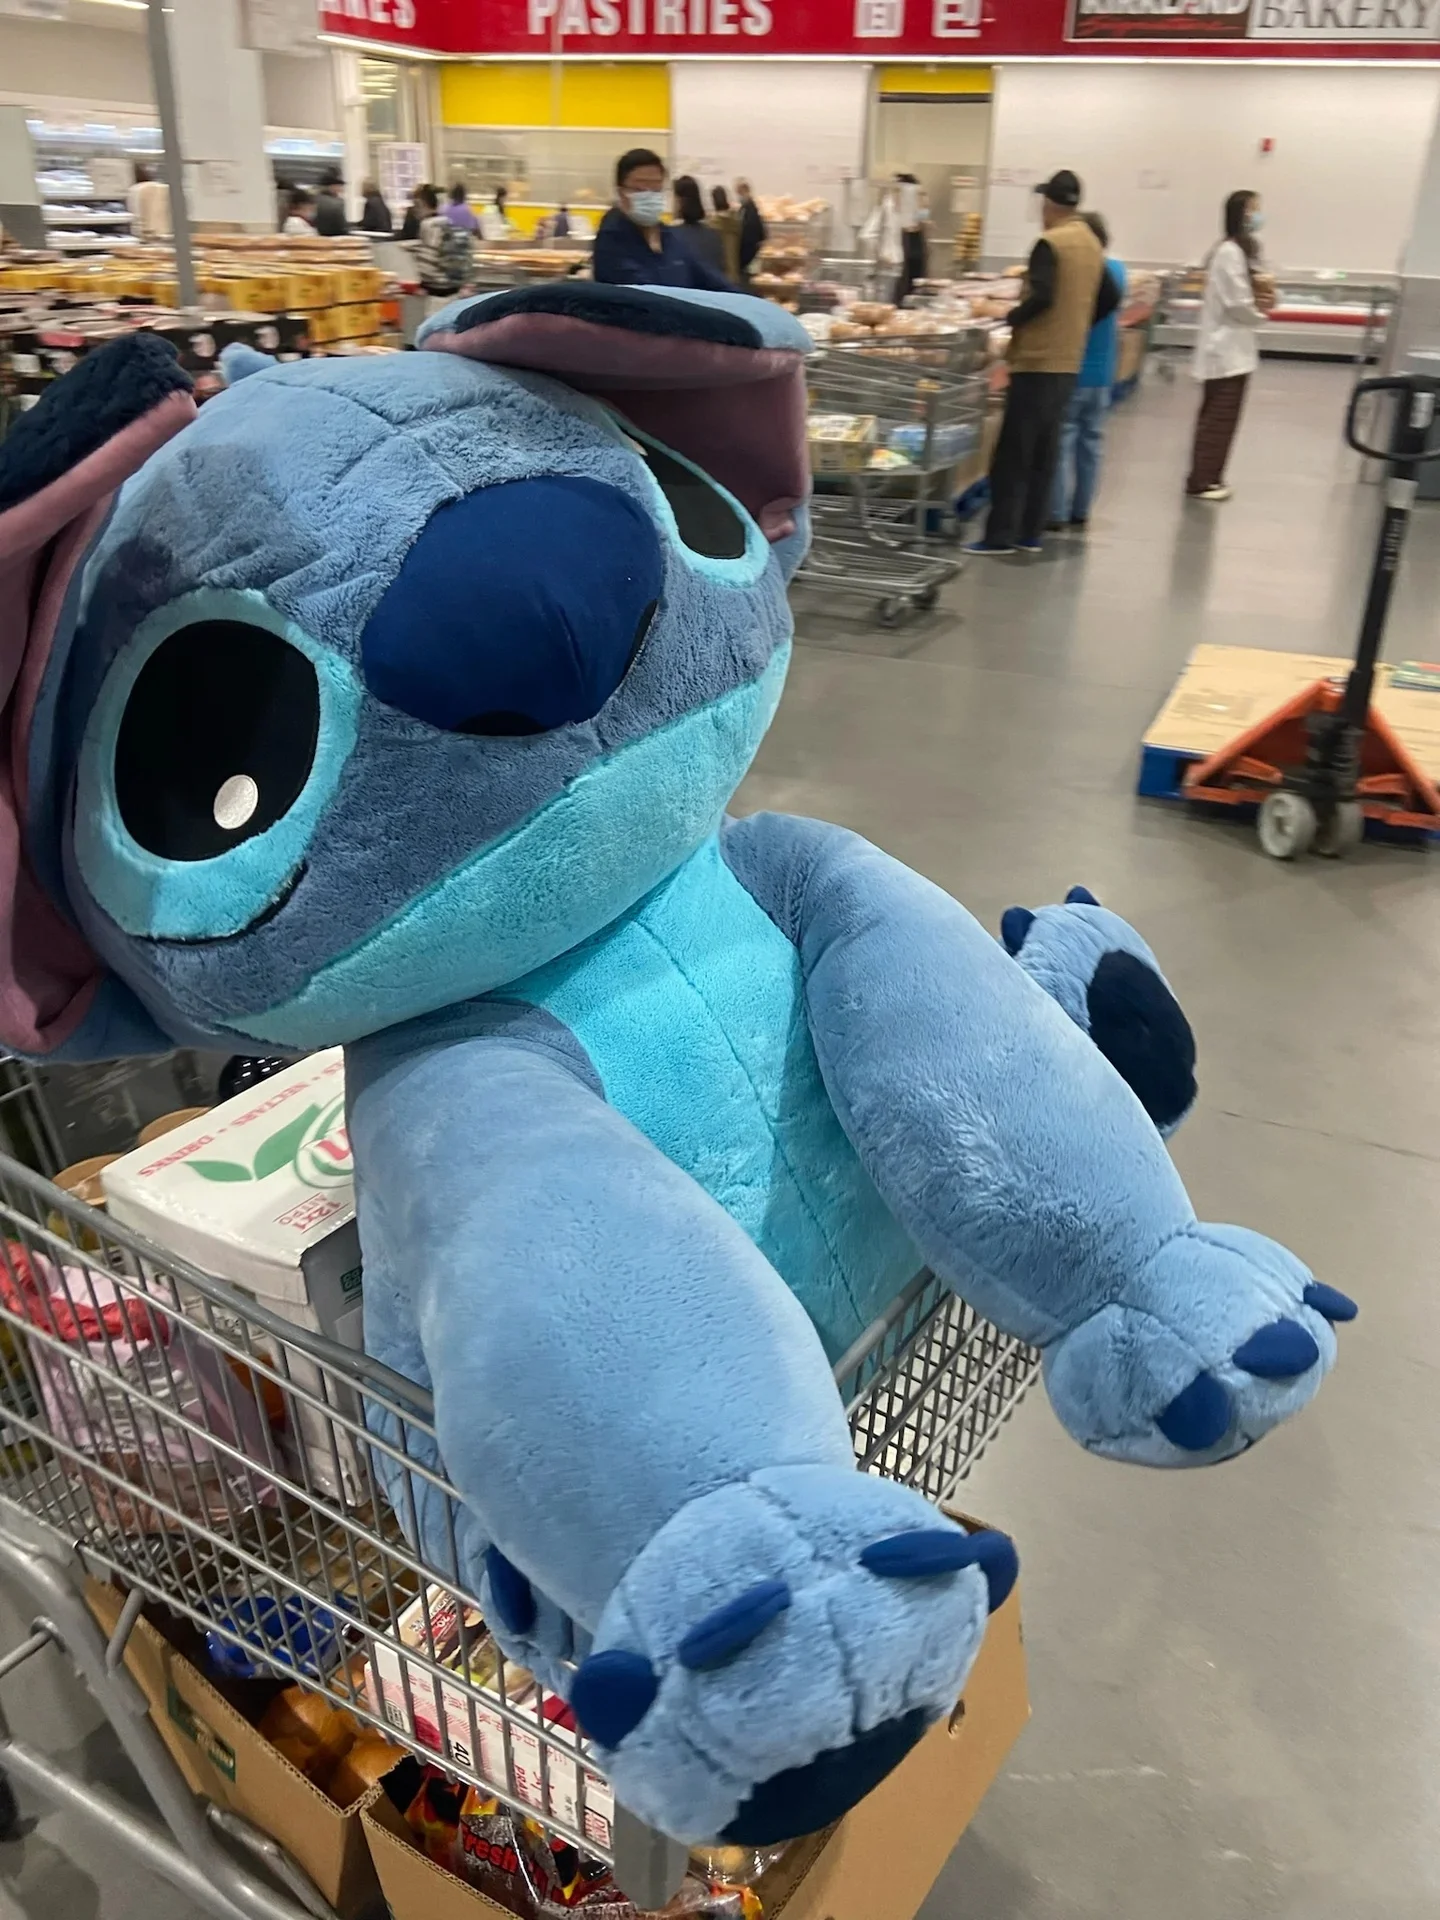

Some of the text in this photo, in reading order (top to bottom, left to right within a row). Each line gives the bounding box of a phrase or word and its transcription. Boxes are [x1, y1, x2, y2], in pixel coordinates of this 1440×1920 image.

[1258, 0, 1431, 29] BAKERY
[138, 1135, 215, 1177] DRINKS
[453, 1741, 471, 1767] 40
